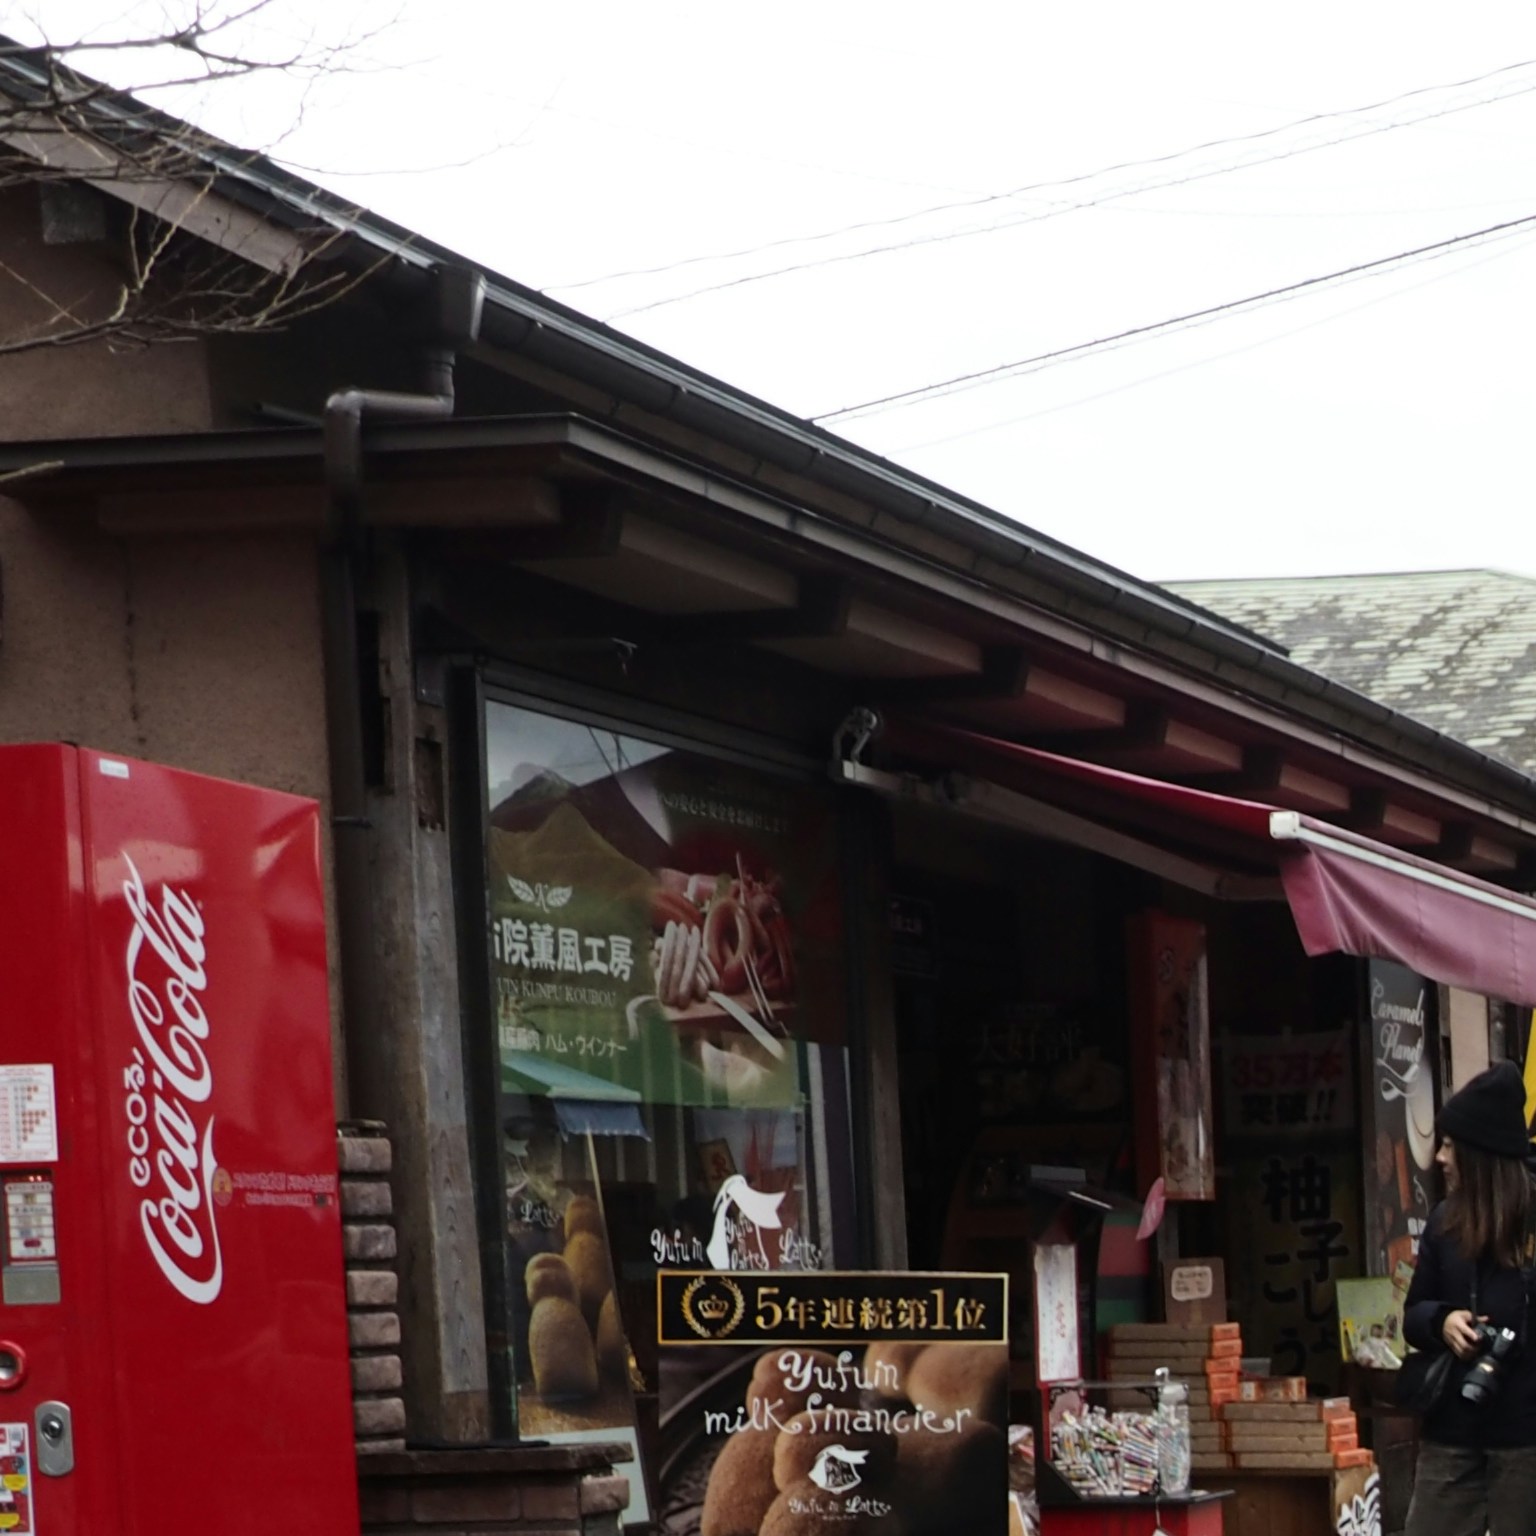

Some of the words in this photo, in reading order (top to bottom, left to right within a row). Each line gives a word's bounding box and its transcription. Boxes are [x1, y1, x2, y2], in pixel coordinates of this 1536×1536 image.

[493, 918, 634, 983] 院薫風工房
[1371, 977, 1425, 1027] Caramel
[1376, 1021, 1425, 1066] Planet
[123, 850, 224, 1305] Coca-Cola
[755, 1287, 987, 1332] 5年連続第1位
[806, 1392, 972, 1436] financier
